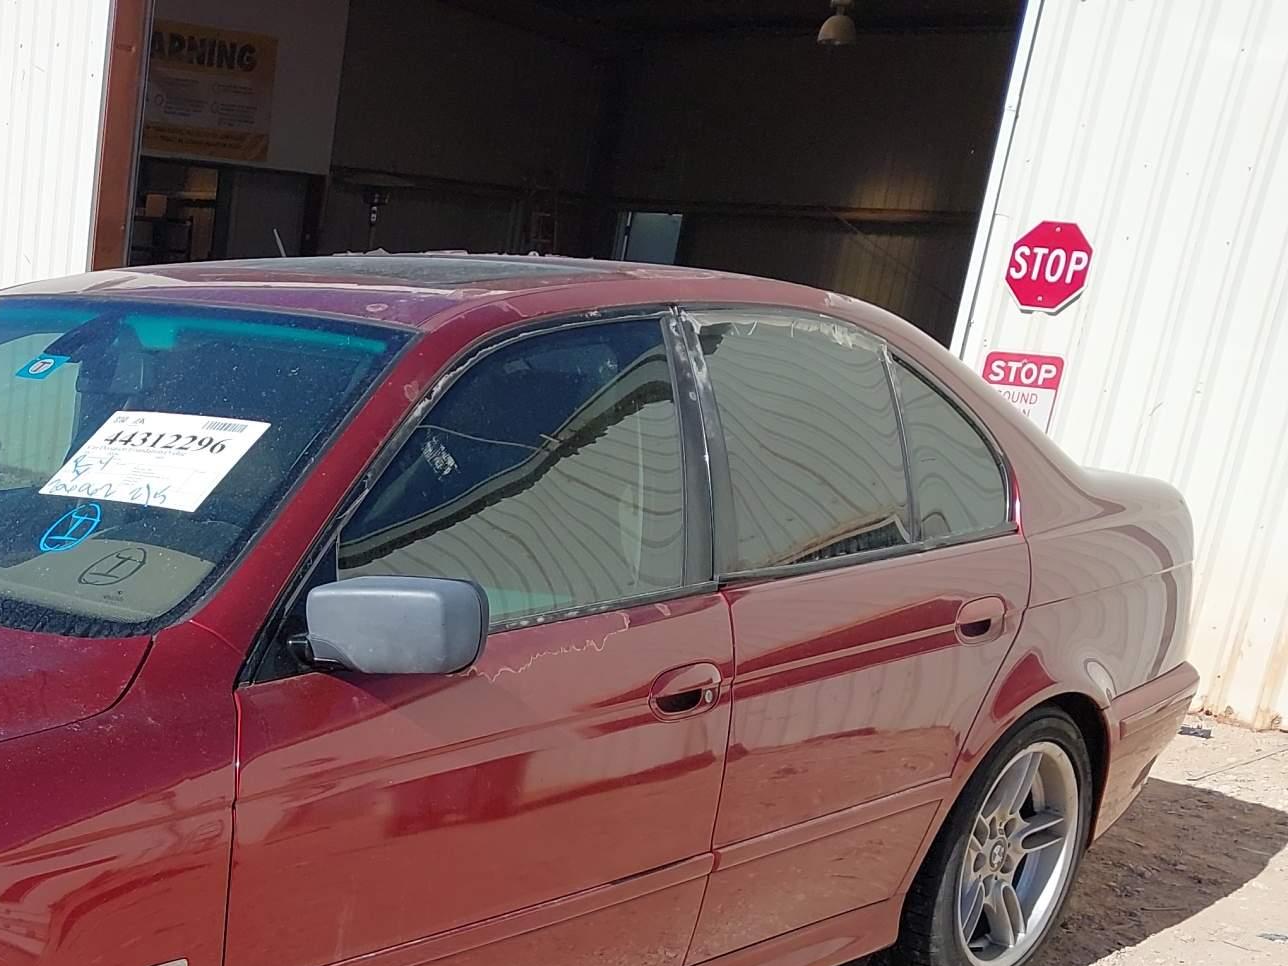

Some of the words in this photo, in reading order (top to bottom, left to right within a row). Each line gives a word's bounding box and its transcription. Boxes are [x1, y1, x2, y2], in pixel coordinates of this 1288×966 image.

[1009, 245, 1089, 285] STOP
[988, 359, 1057, 386] STOP
[998, 389, 1038, 405] OUND
[104, 430, 233, 454] 44312296
